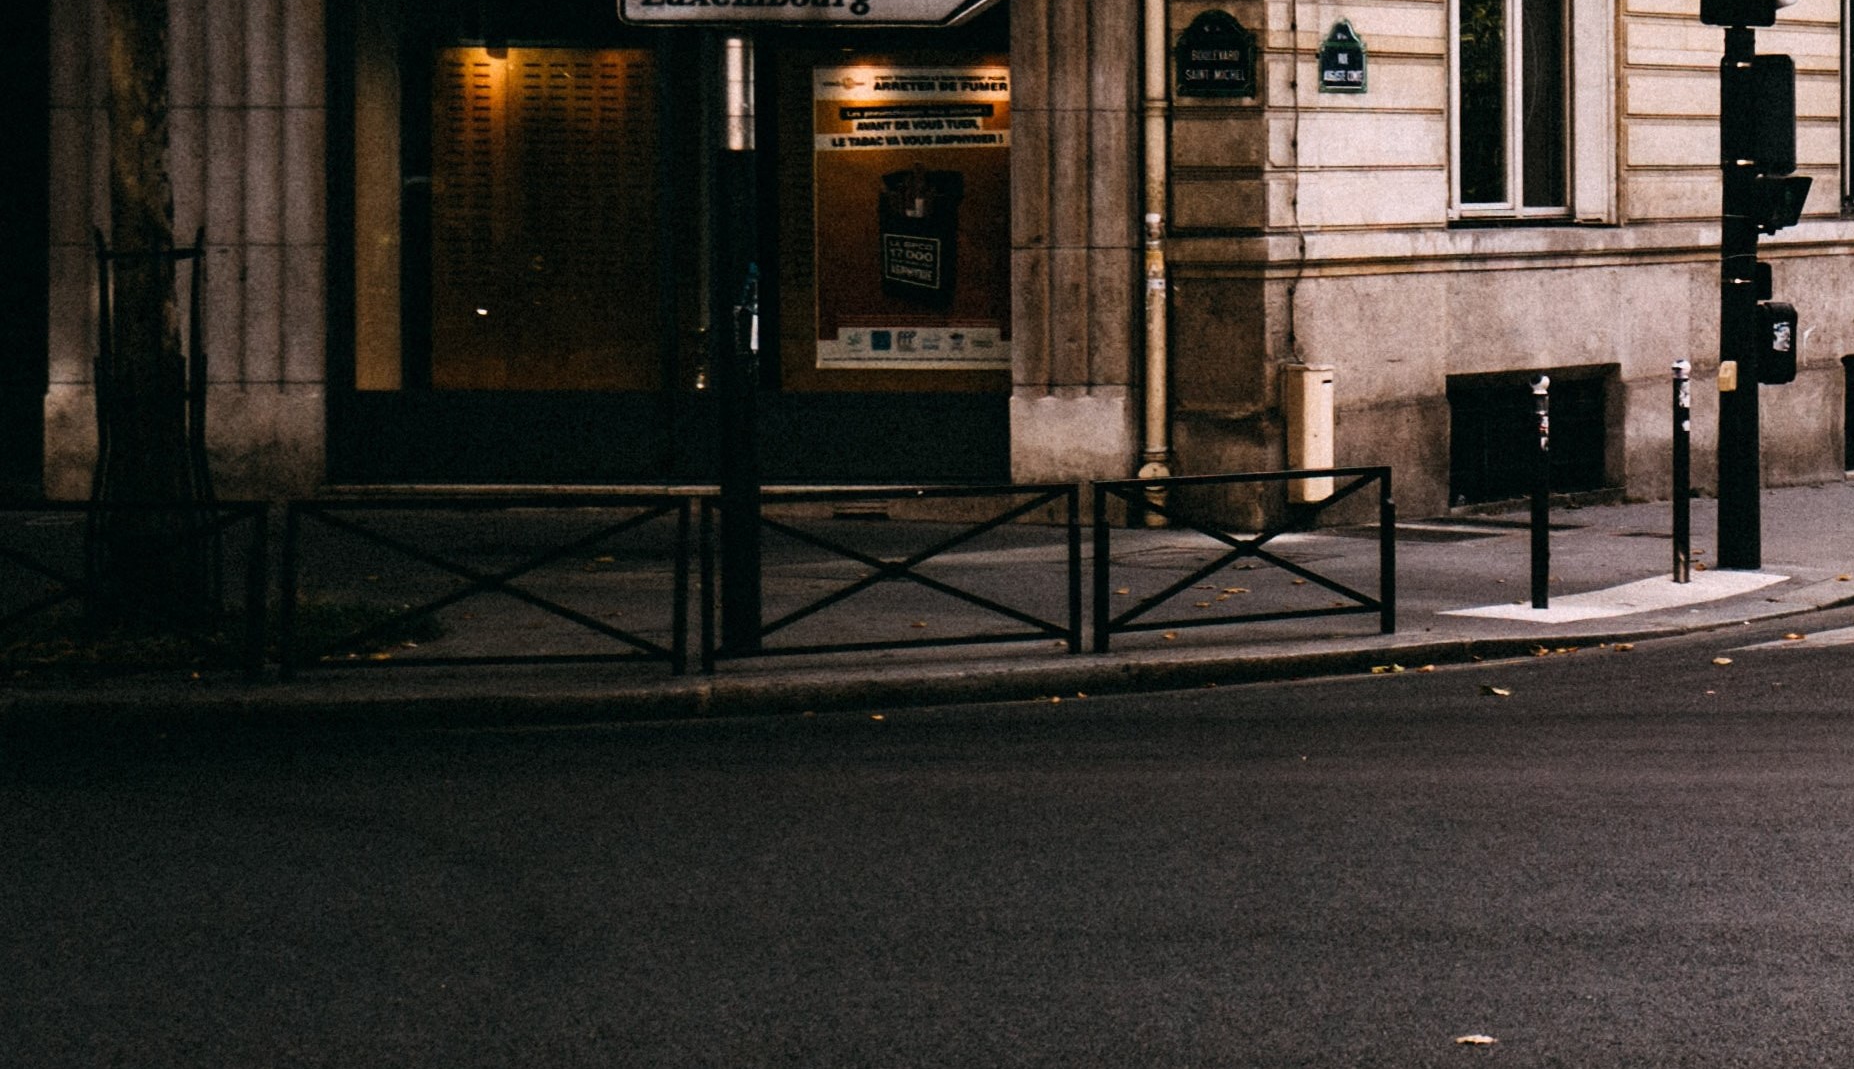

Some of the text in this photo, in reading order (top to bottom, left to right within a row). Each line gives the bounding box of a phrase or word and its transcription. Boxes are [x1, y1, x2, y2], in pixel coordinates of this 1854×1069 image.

[939, 82, 957, 92] DE
[961, 82, 1008, 92] FUMER
[856, 121, 892, 131] AVANT
[895, 121, 909, 131] DE
[912, 120, 944, 130] VOUS
[832, 138, 846, 147] LE
